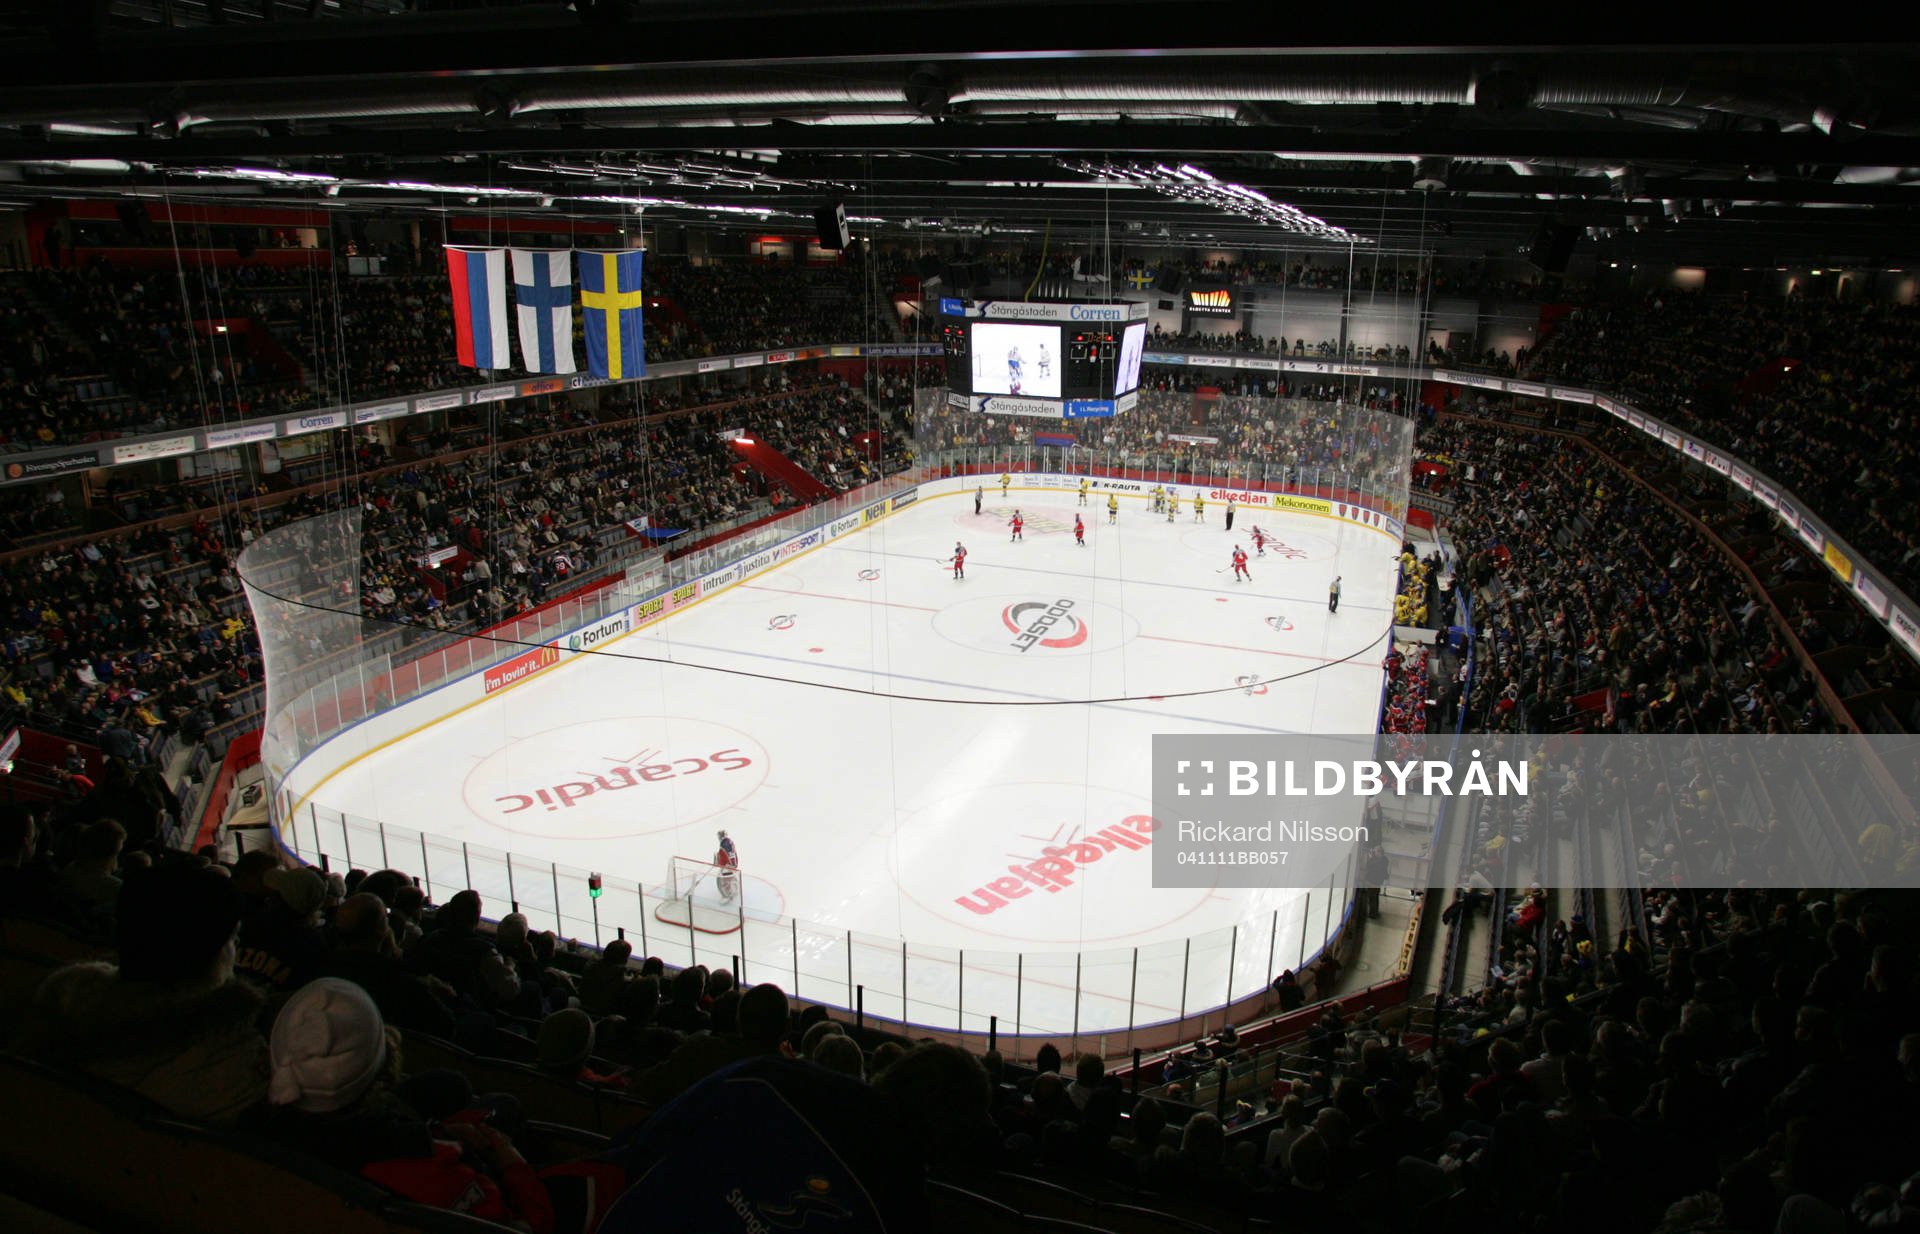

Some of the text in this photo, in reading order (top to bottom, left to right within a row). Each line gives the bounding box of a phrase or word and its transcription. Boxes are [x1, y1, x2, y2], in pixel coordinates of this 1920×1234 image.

[991, 304, 1057, 319] Stångåstaden
[1070, 304, 1121, 321] Corren
[990, 402, 1056, 415] Stångåstaden
[300, 415, 334, 430] Corren
[1104, 482, 1141, 492] K-RAUTA
[1210, 488, 1268, 506] elkedjan
[1275, 496, 1330, 513] Mekonomen
[838, 517, 858, 532] Fortum
[780, 532, 819, 557] INTERSPORT
[743, 554, 770, 577] justitia
[703, 569, 733, 593] intrum
[672, 584, 696, 604] SPORT
[638, 597, 664, 619] SPORT
[582, 619, 623, 646] Fortum
[1010, 599, 1075, 652] ODDSET
[495, 748, 752, 814] Scandic
[954, 814, 1163, 915] elkedjan
